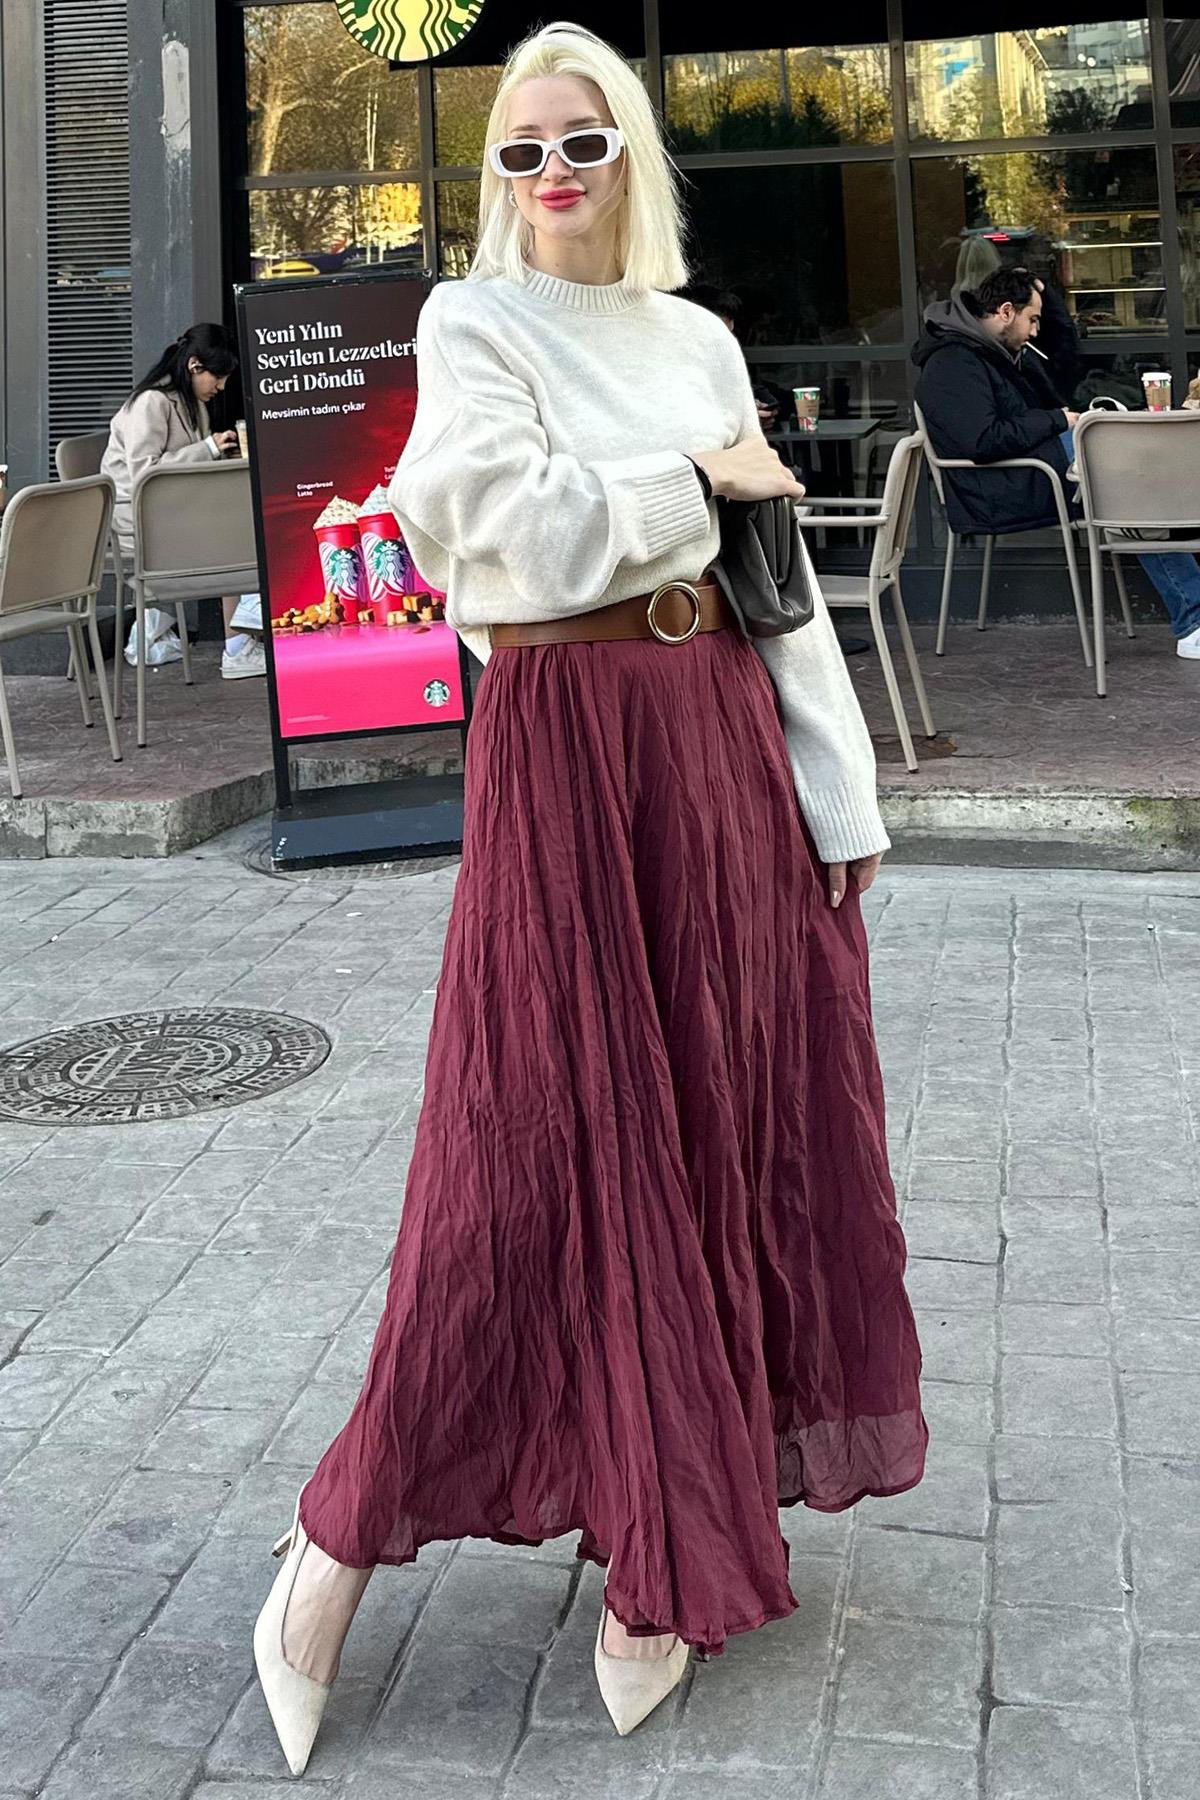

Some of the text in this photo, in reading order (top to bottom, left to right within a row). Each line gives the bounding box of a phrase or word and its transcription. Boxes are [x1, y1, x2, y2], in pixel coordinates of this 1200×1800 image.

[255, 322, 343, 345] Yeni Yılın
[257, 338, 417, 370] Sevilen Lezzetleri
[259, 369, 365, 395] Geri Döndü
[261, 401, 366, 420] Mevsimin tadını çıkar
[296, 481, 334, 490] Gingerbread
